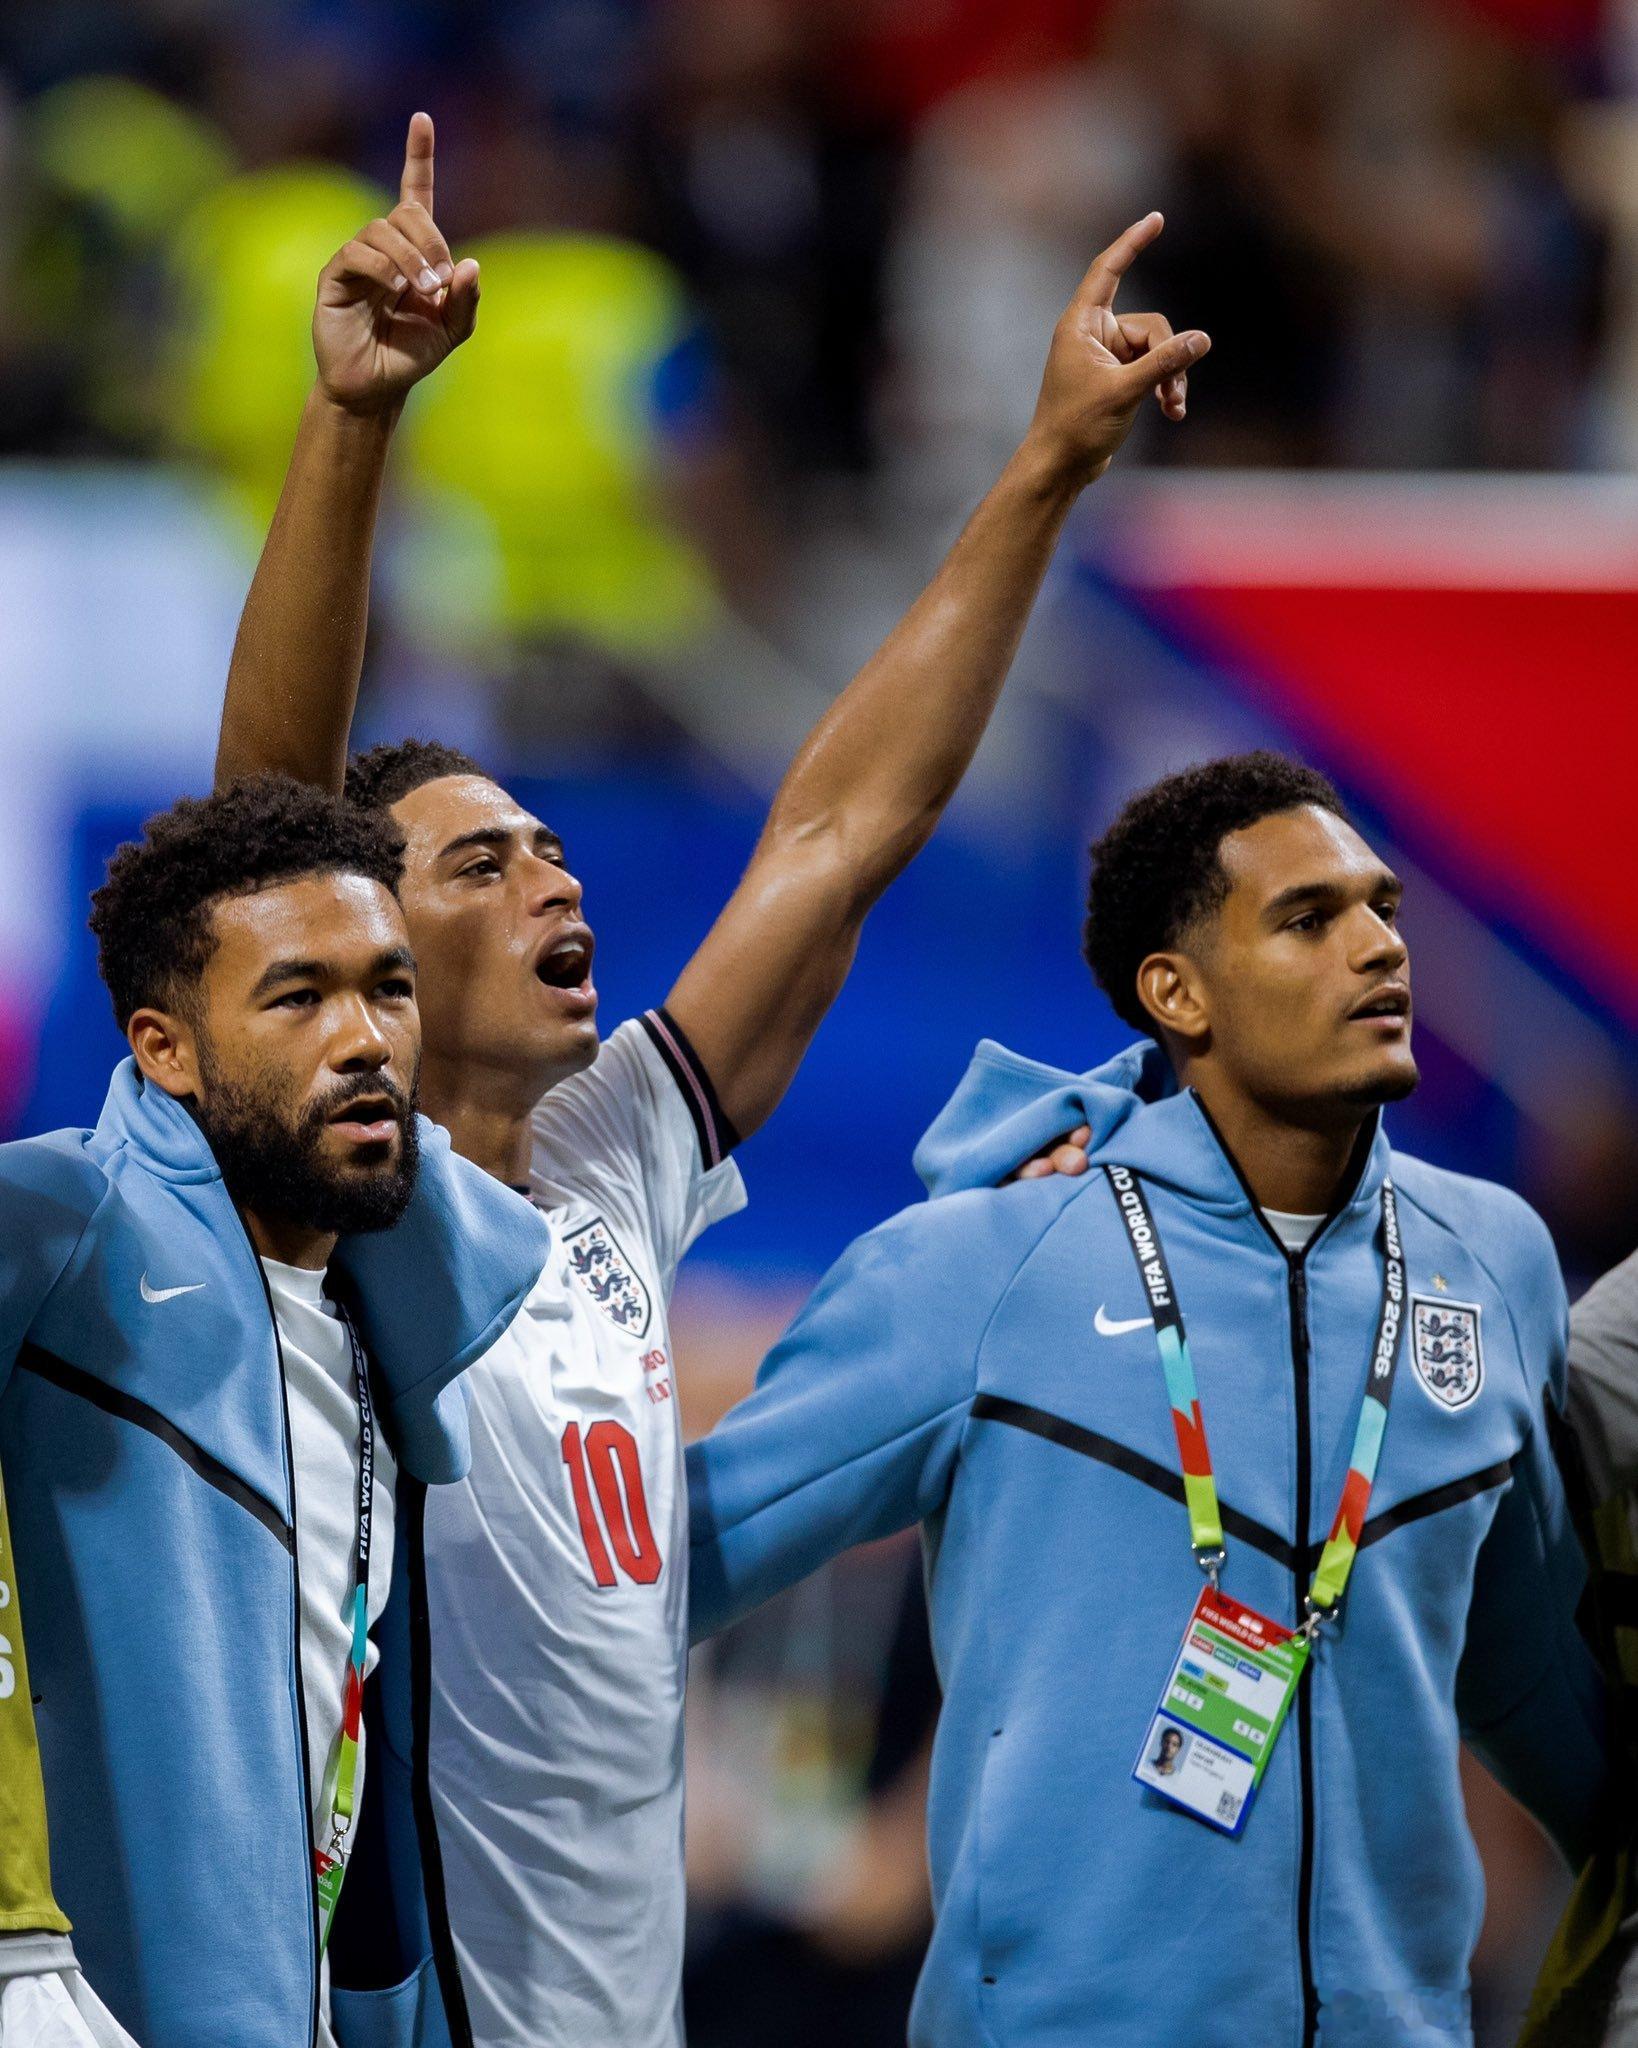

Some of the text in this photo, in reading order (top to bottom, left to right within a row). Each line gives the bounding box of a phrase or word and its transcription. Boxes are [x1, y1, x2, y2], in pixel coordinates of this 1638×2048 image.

[1108, 1165, 1171, 1307] FIFA WORLD CU
[1386, 1260, 1403, 1301] CUP
[1374, 1302, 1401, 1379] 2026
[357, 1380, 372, 1424] CUP
[360, 1428, 373, 1512] WORLD
[561, 1419, 663, 1587] 10
[359, 1512, 371, 1561] FIFA
